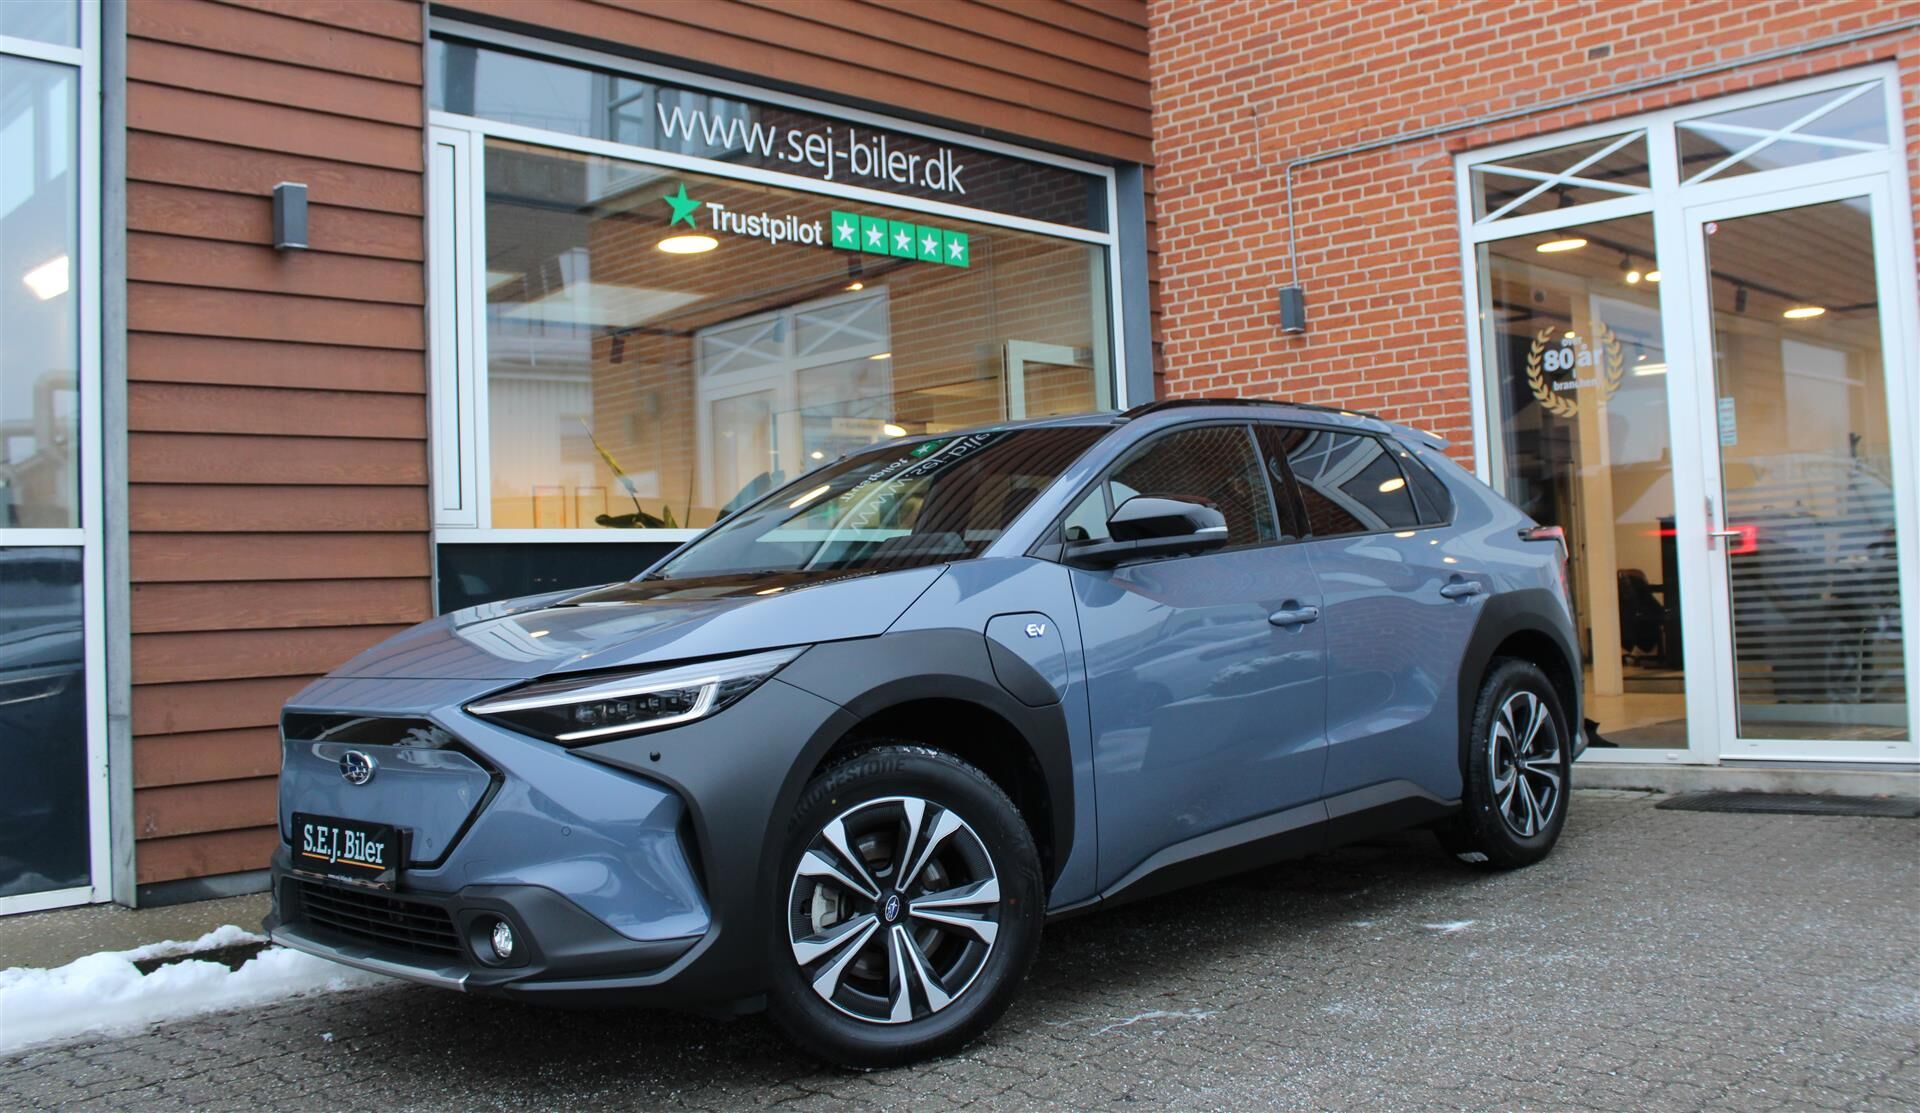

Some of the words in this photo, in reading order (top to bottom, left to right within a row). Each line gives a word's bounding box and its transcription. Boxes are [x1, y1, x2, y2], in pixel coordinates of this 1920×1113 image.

[656, 102, 966, 195] www.sej-biler.dk
[706, 202, 824, 246] Trustpilot
[1543, 348, 1574, 372] 80
[1577, 344, 1602, 367] år
[1561, 337, 1582, 347] over
[1024, 623, 1046, 638] EV
[303, 823, 341, 864] S.E.J.
[344, 829, 385, 864] Biler
